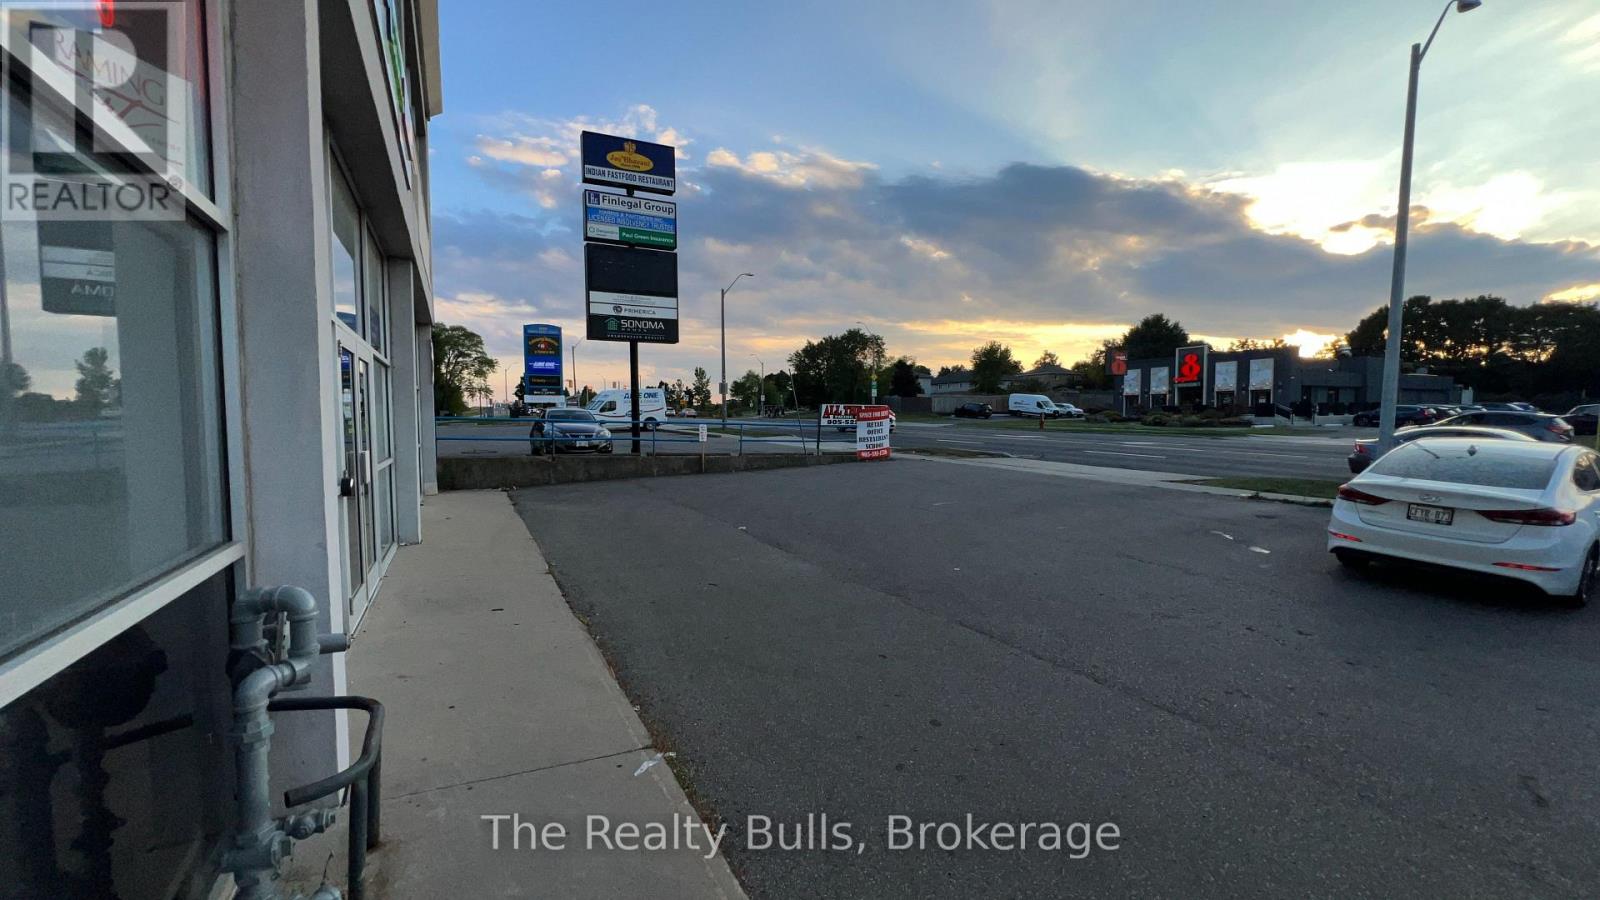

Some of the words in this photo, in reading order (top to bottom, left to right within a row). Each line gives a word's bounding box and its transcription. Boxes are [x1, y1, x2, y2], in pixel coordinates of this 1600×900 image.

[585, 167, 606, 177] INDIAN
[607, 170, 637, 182] FASTFOOD
[638, 175, 674, 188] RESTAURANT
[601, 195, 642, 210] Finlegal
[643, 202, 674, 215] Group
[624, 307, 657, 315] PRIMERICA
[621, 319, 665, 330] SONOMA
